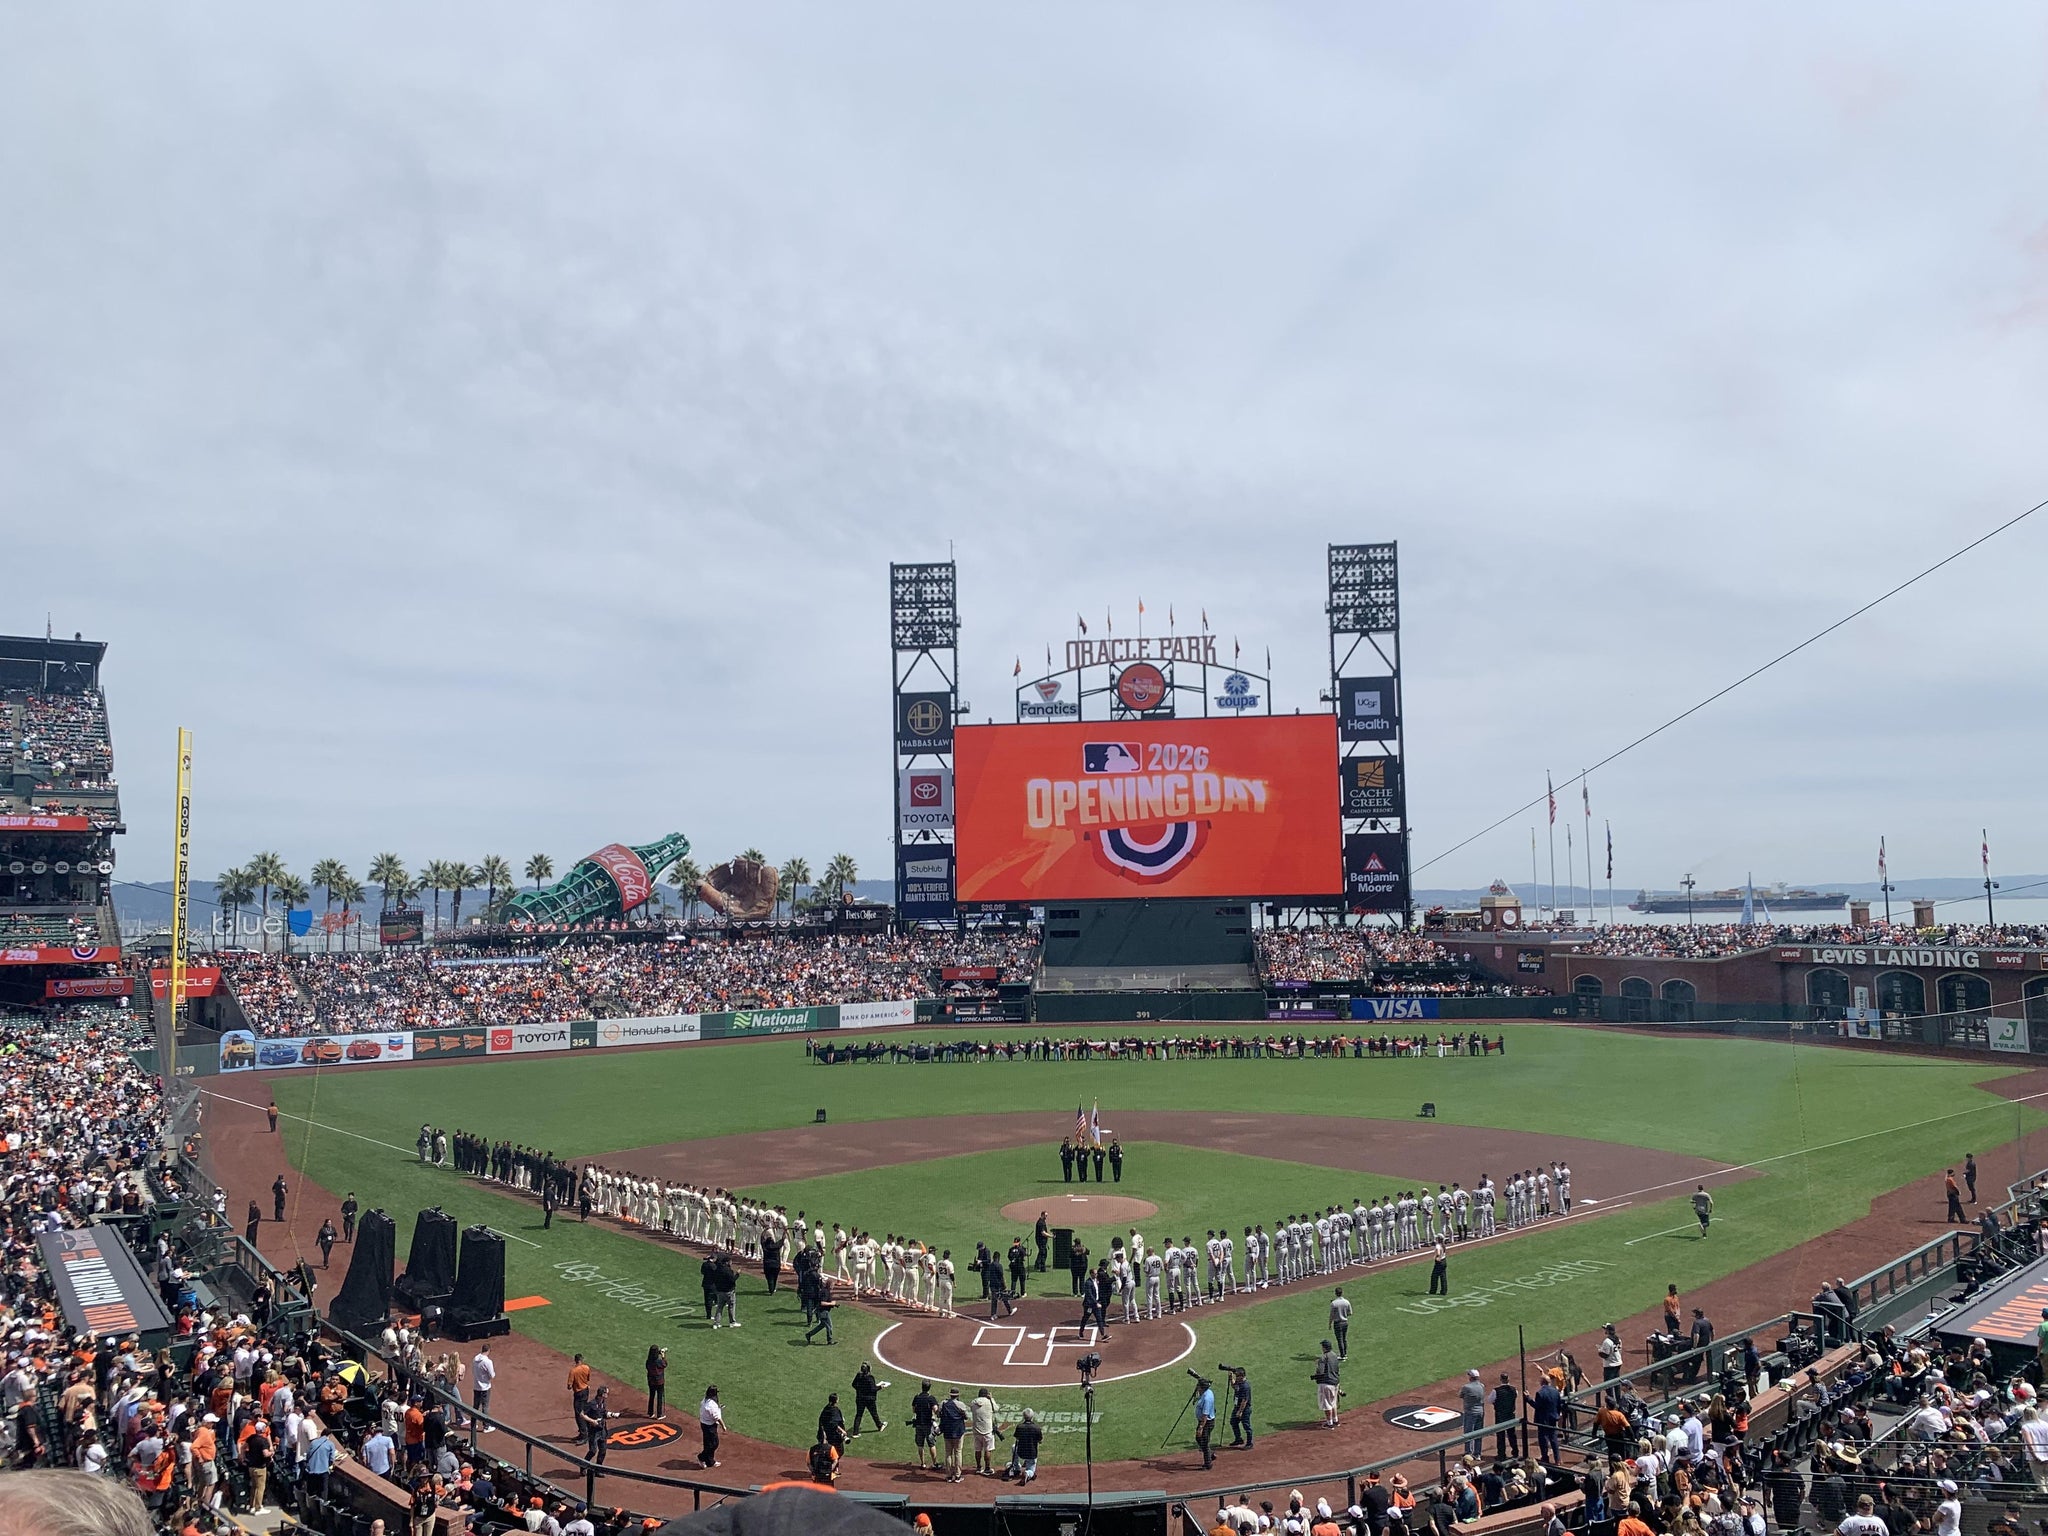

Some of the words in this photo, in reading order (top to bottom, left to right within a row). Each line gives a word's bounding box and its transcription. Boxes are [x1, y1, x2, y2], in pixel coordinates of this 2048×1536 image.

[1066, 638, 1150, 671] ORACLE
[1158, 635, 1218, 666] PARK
[1218, 697, 1257, 707] coupa
[1357, 698, 1378, 708] UCSF
[1020, 703, 1077, 716] Fanatics
[1347, 718, 1390, 730] Health
[901, 740, 932, 748] HABBAS
[1148, 743, 1210, 771] 2026
[1350, 788, 1393, 798] CACHE
[1026, 772, 1190, 829] OPENING
[1192, 772, 1266, 815] DAY
[1351, 798, 1392, 807] CREEK
[180, 796, 189, 838] ROOT
[903, 814, 950, 824] TOYOTA
[180, 843, 188, 857] 4
[911, 864, 942, 873] StubHub
[178, 862, 187, 893] THA
[1350, 872, 1399, 884] Benjamin
[907, 884, 922, 892] 100%
[922, 883, 948, 891] VERIFIED
[1358, 881, 1393, 892] Moore
[905, 893, 926, 902] GIANTS
[926, 892, 949, 901] TICKETS
[177, 897, 187, 961] CHIKIN
[212, 911, 283, 936] blue
[1874, 951, 1980, 968] LANDING
[1136, 1011, 1150, 1019] 391
[1367, 1000, 1424, 1019] VISA
[1552, 1007, 1567, 1015] 415
[752, 1011, 810, 1028] National
[869, 1012, 898, 1020] AMERICA
[622, 1025, 671, 1038] Hanwha
[673, 1023, 696, 1034] Life
[783, 1024, 806, 1033] Rental
[518, 1031, 566, 1044] TOYOTA
[572, 1038, 590, 1046] 354
[1993, 1042, 2009, 1050] EVA
[68, 1269, 125, 1306] FRANCISCO
[1395, 1291, 1495, 1316] UCSF
[1472, 1258, 1618, 1296] Health
[584, 1277, 697, 1319] Health
[1859, 1525, 1880, 1533] CLARK
